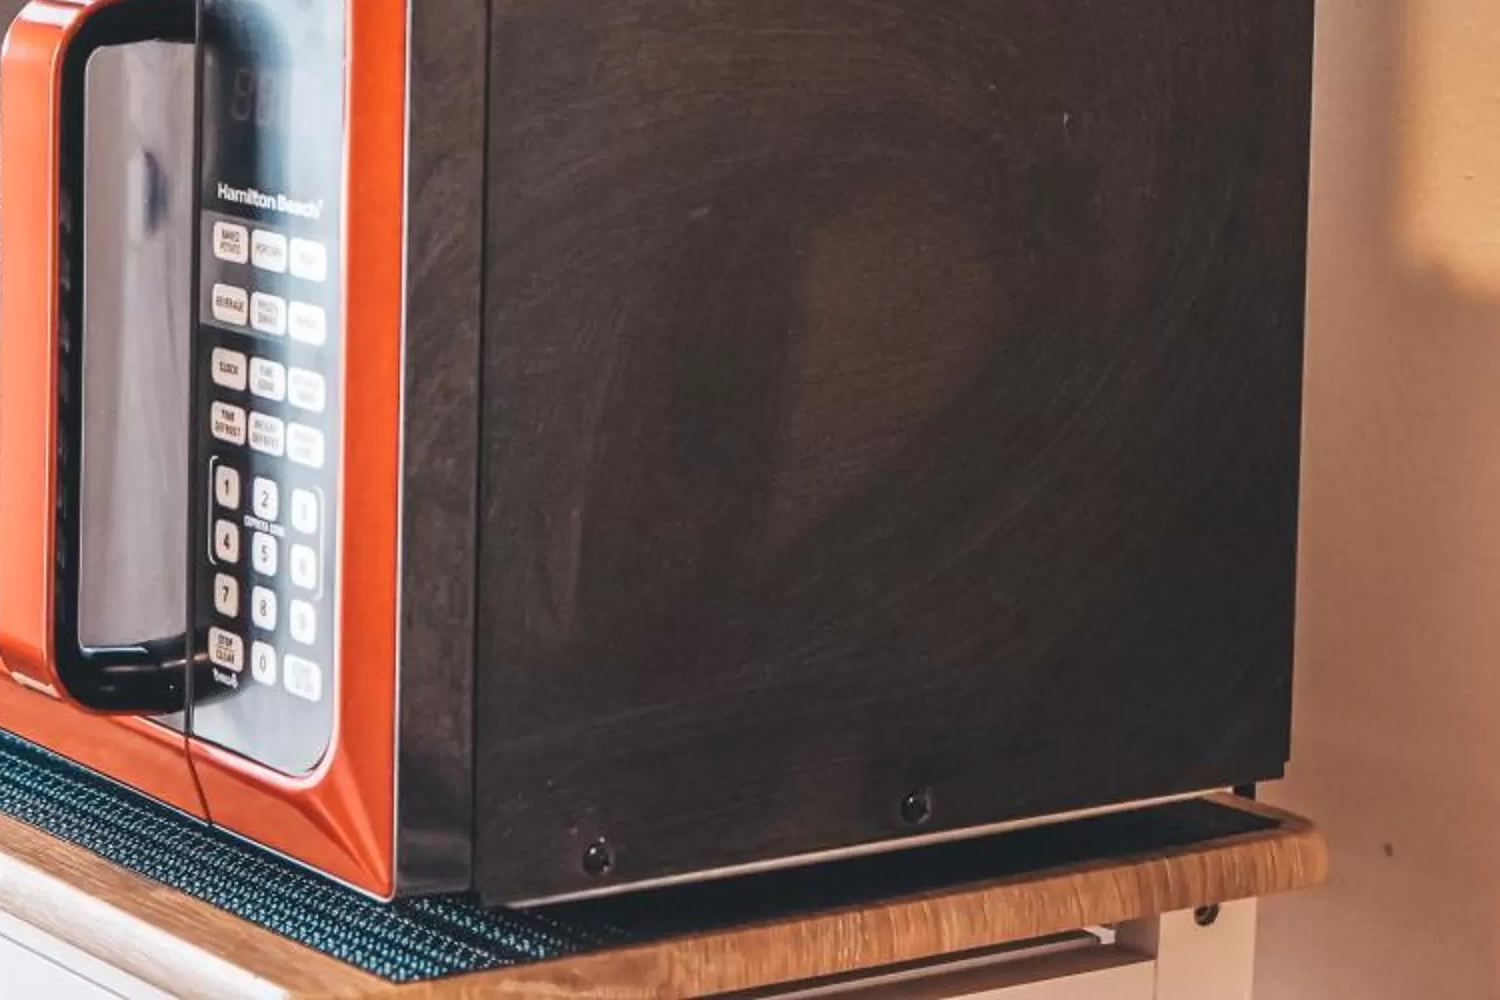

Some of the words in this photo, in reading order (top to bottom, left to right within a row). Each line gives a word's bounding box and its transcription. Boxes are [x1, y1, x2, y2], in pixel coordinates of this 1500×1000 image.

[217, 181, 276, 211] Hamilton
[261, 490, 269, 508] 2
[223, 533, 231, 549] 4
[261, 545, 268, 563] 5
[222, 588, 229, 603] 7
[260, 600, 268, 617] 8
[259, 655, 267, 672] 0
